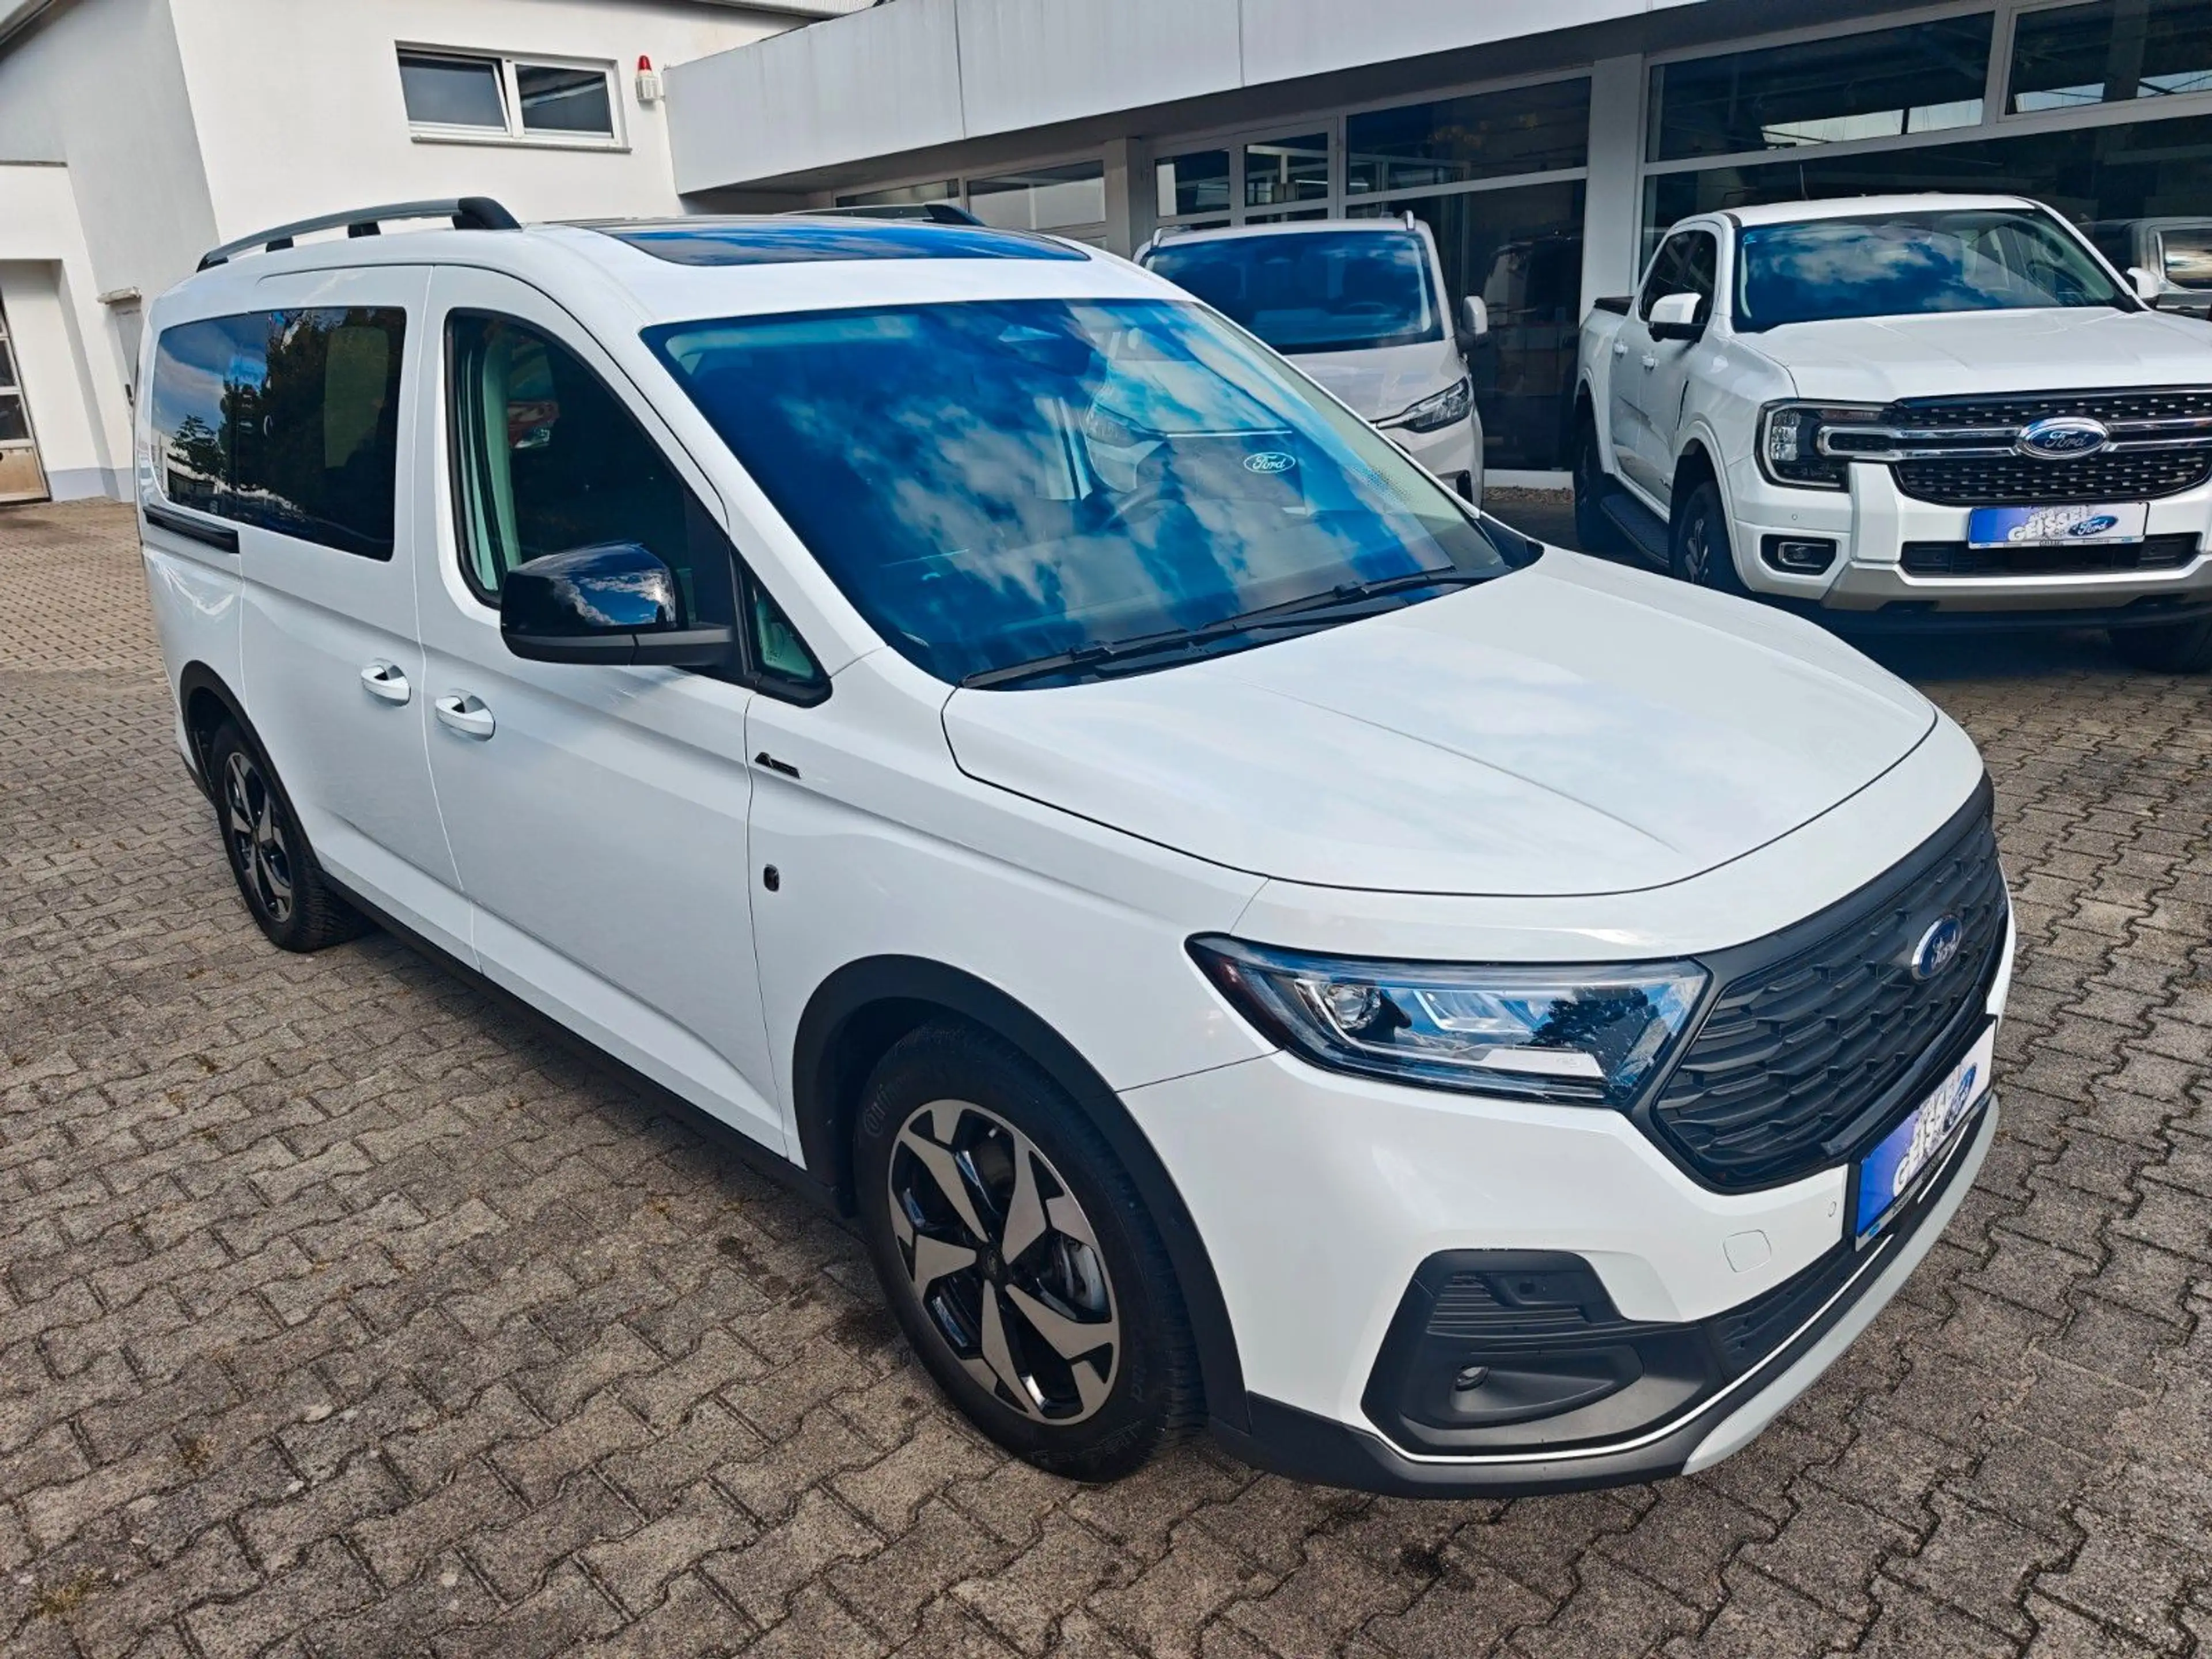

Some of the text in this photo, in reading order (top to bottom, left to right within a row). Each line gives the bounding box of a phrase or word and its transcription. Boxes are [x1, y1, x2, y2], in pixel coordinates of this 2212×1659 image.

[2045, 431, 2089, 448] Ford
[1252, 455, 1287, 469] Ford
[2077, 518, 2108, 535] Ford
